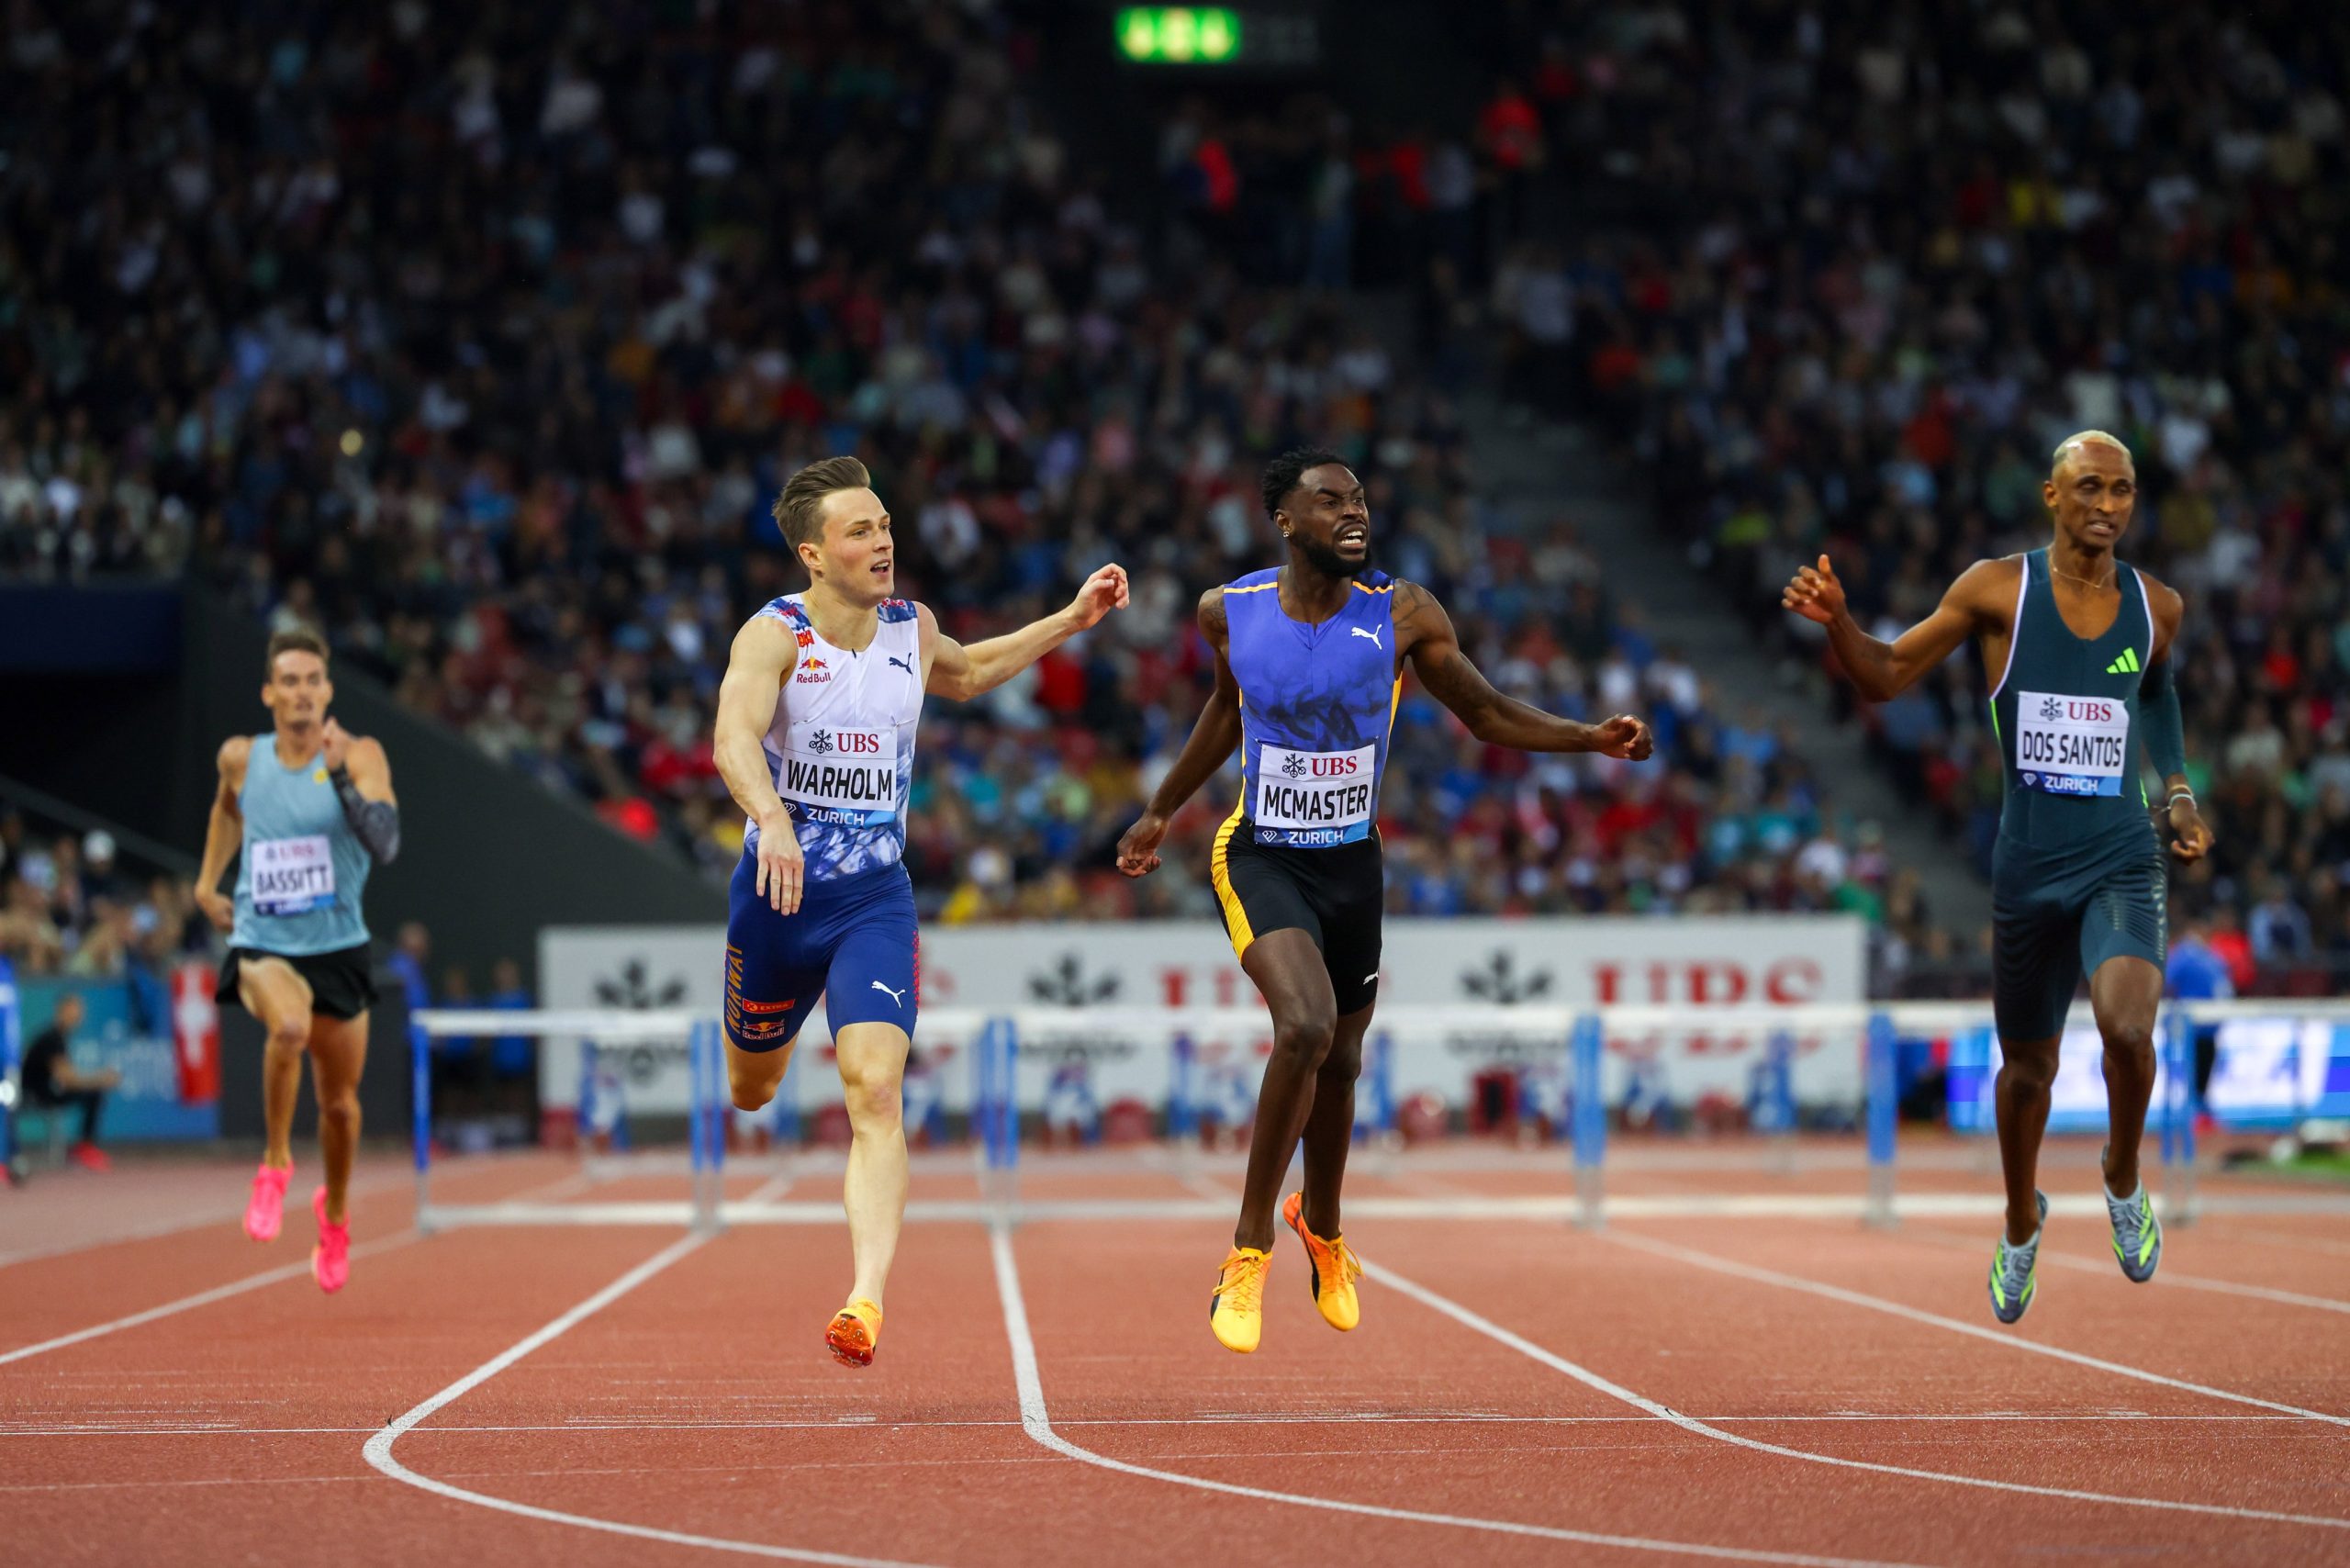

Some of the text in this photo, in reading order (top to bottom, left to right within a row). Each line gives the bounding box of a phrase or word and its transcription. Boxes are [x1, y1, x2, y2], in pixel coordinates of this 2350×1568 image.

[797, 672, 831, 683] Red Bull
[2068, 701, 2111, 722] UBS
[837, 734, 879, 753] UBS
[2023, 731, 2122, 767] DOS SANTOS
[1311, 756, 1357, 777] UBS
[787, 759, 892, 801] WARHOLM
[2044, 775, 2098, 791] ZURICH
[1263, 784, 1369, 821] MCMASTER
[807, 809, 865, 826] ZURICH
[1288, 830, 1344, 845] ZURICH
[256, 864, 327, 895] BASSITT
[726, 943, 743, 1035] NORWAY
